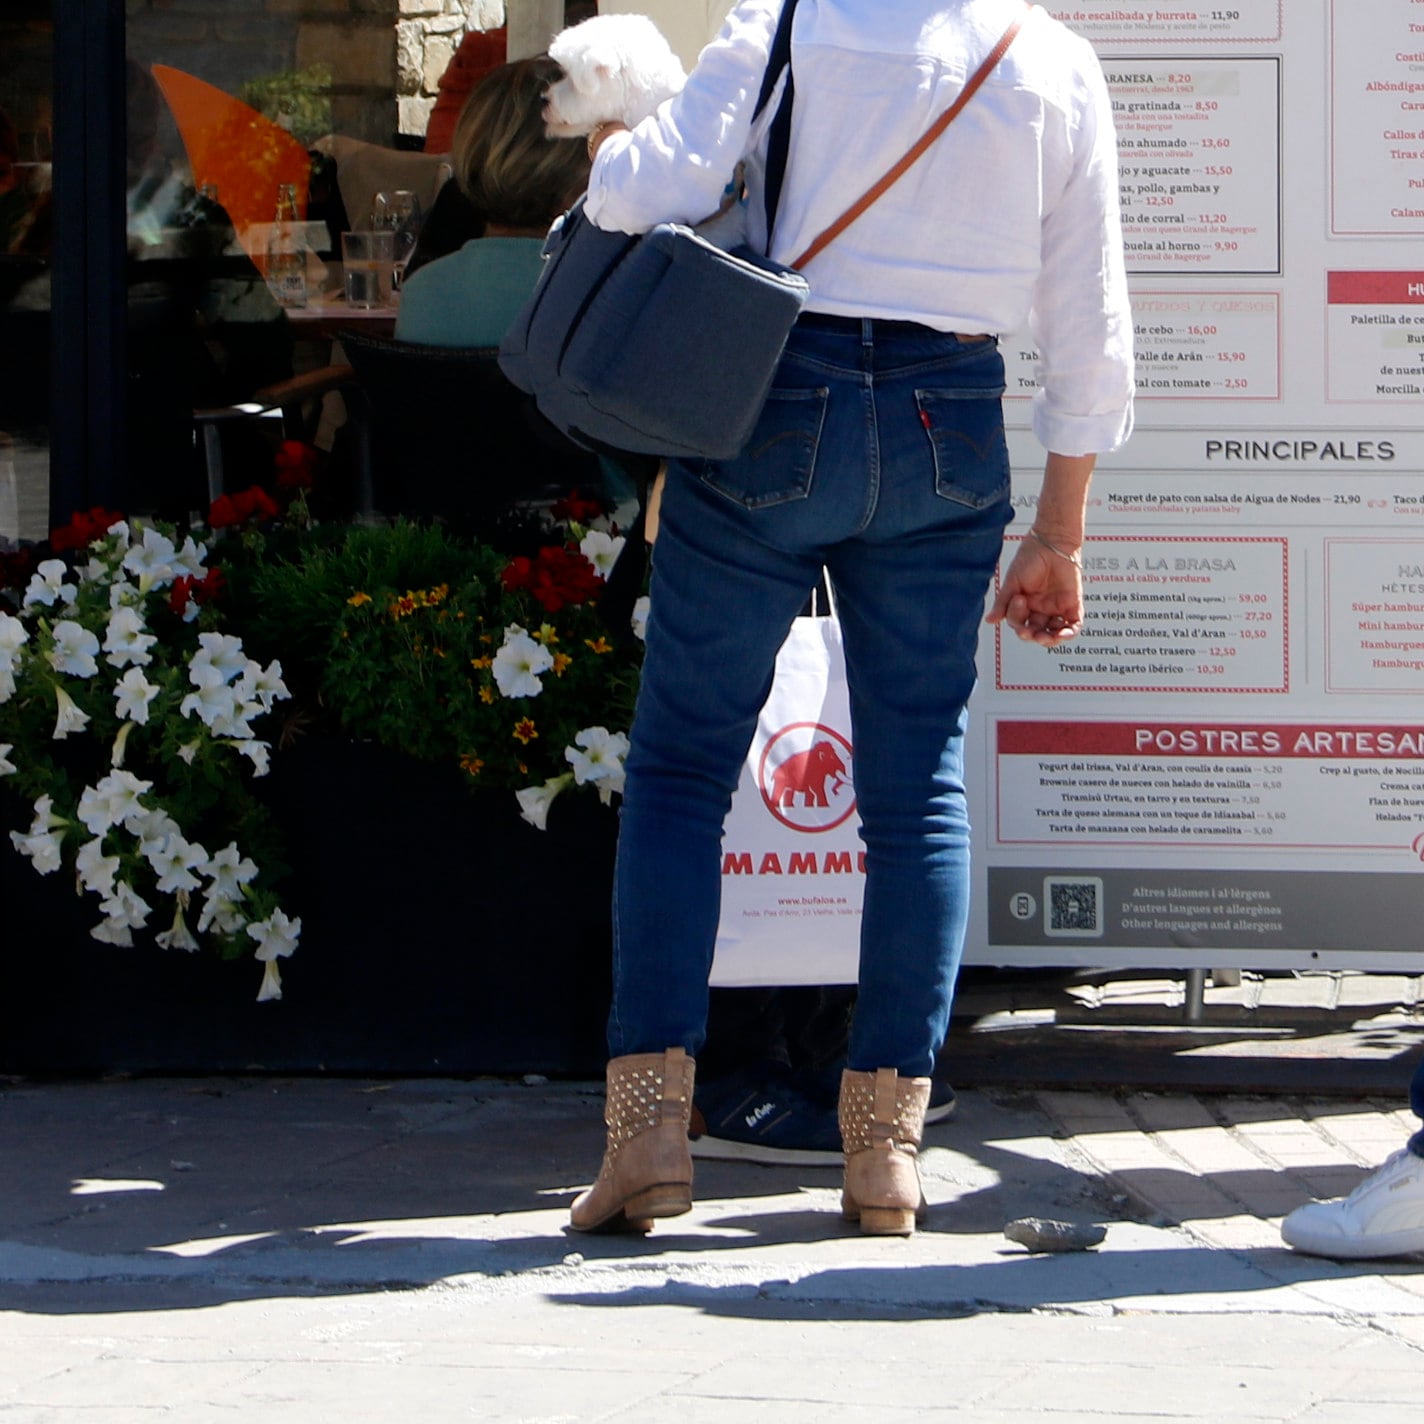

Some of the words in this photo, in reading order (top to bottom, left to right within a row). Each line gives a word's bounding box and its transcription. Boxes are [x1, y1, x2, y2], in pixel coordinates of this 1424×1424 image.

[1073, 11, 1086, 21] de
[1088, 11, 1146, 21] escalibada
[1148, 13, 1154, 23] y
[1156, 12, 1197, 21] burrata
[1211, 11, 1240, 22] 11,90
[1168, 74, 1191, 84] 8,20
[1128, 101, 1181, 113] gratinada
[1195, 101, 1218, 111] 8,50
[1137, 139, 1187, 148] ahumado
[1201, 138, 1230, 148] 13,60
[1134, 167, 1139, 176] y
[1142, 167, 1190, 176] aguacate
[1205, 166, 1233, 175] 15,50
[1138, 184, 1167, 194] pollo,
[1169, 184, 1211, 195] gambas
[1213, 185, 1220, 194] y
[1146, 197, 1174, 206] 12,50
[1137, 214, 1150, 223] de
[1152, 214, 1184, 223] corral
[1199, 214, 1227, 224] 11,20
[1124, 242, 1153, 250] buela
[1156, 242, 1166, 250] al
[1169, 242, 1200, 250] horno
[1214, 242, 1238, 251] 9,90
[1351, 315, 1396, 324] Paletilla
[1398, 315, 1411, 324] de
[1134, 325, 1147, 335] de
[1149, 325, 1174, 335] cebo
[1187, 325, 1217, 336] 16,00
[1162, 352, 1175, 361] de
[1177, 351, 1203, 361] Arán
[1217, 352, 1245, 362] 15,90
[1150, 380, 1170, 388] con
[1172, 379, 1211, 388] tomate
[1224, 379, 1248, 389] 2,50
[1376, 384, 1420, 394] Morcilla
[1204, 439, 1397, 462] PRINCIPALES
[1108, 493, 1144, 504] Magret
[1146, 493, 1158, 502] de
[1160, 495, 1182, 504] pato
[1203, 494, 1228, 503] salsa
[1230, 494, 1242, 503] de
[1244, 494, 1274, 505] Aigua
[1276, 495, 1288, 503] de
[1291, 495, 1321, 503] Nodes
[1333, 495, 1361, 504] 21,90
[1127, 558, 1139, 571] A
[1145, 558, 1169, 571] LA
[1174, 558, 1237, 571] BRASA
[1103, 593, 1127, 603] vieja
[1130, 593, 1186, 603] Simmental
[1239, 594, 1267, 603] 59,00
[1352, 602, 1381, 613] Súper
[1048, 646, 1072, 655] Pollo
[1074, 647, 1086, 655] de
[1089, 647, 1121, 657] corral,
[1159, 648, 1196, 656] trasero
[1209, 648, 1236, 657] 12,50
[1058, 663, 1093, 673] Trenza
[1095, 664, 1107, 673] de
[1109, 664, 1146, 676] lagarto
[1148, 664, 1183, 673] ibérico
[1197, 665, 1224, 674] 10,30
[1135, 729, 1280, 752] POSTRES
[1061, 793, 1102, 803] Tiramisú
[1104, 794, 1132, 803] Urtau,
[1121, 919, 1153, 930] Other
[1155, 920, 1208, 932] lenguages
[1210, 920, 1230, 930] and
[1233, 921, 1283, 932] allergens
